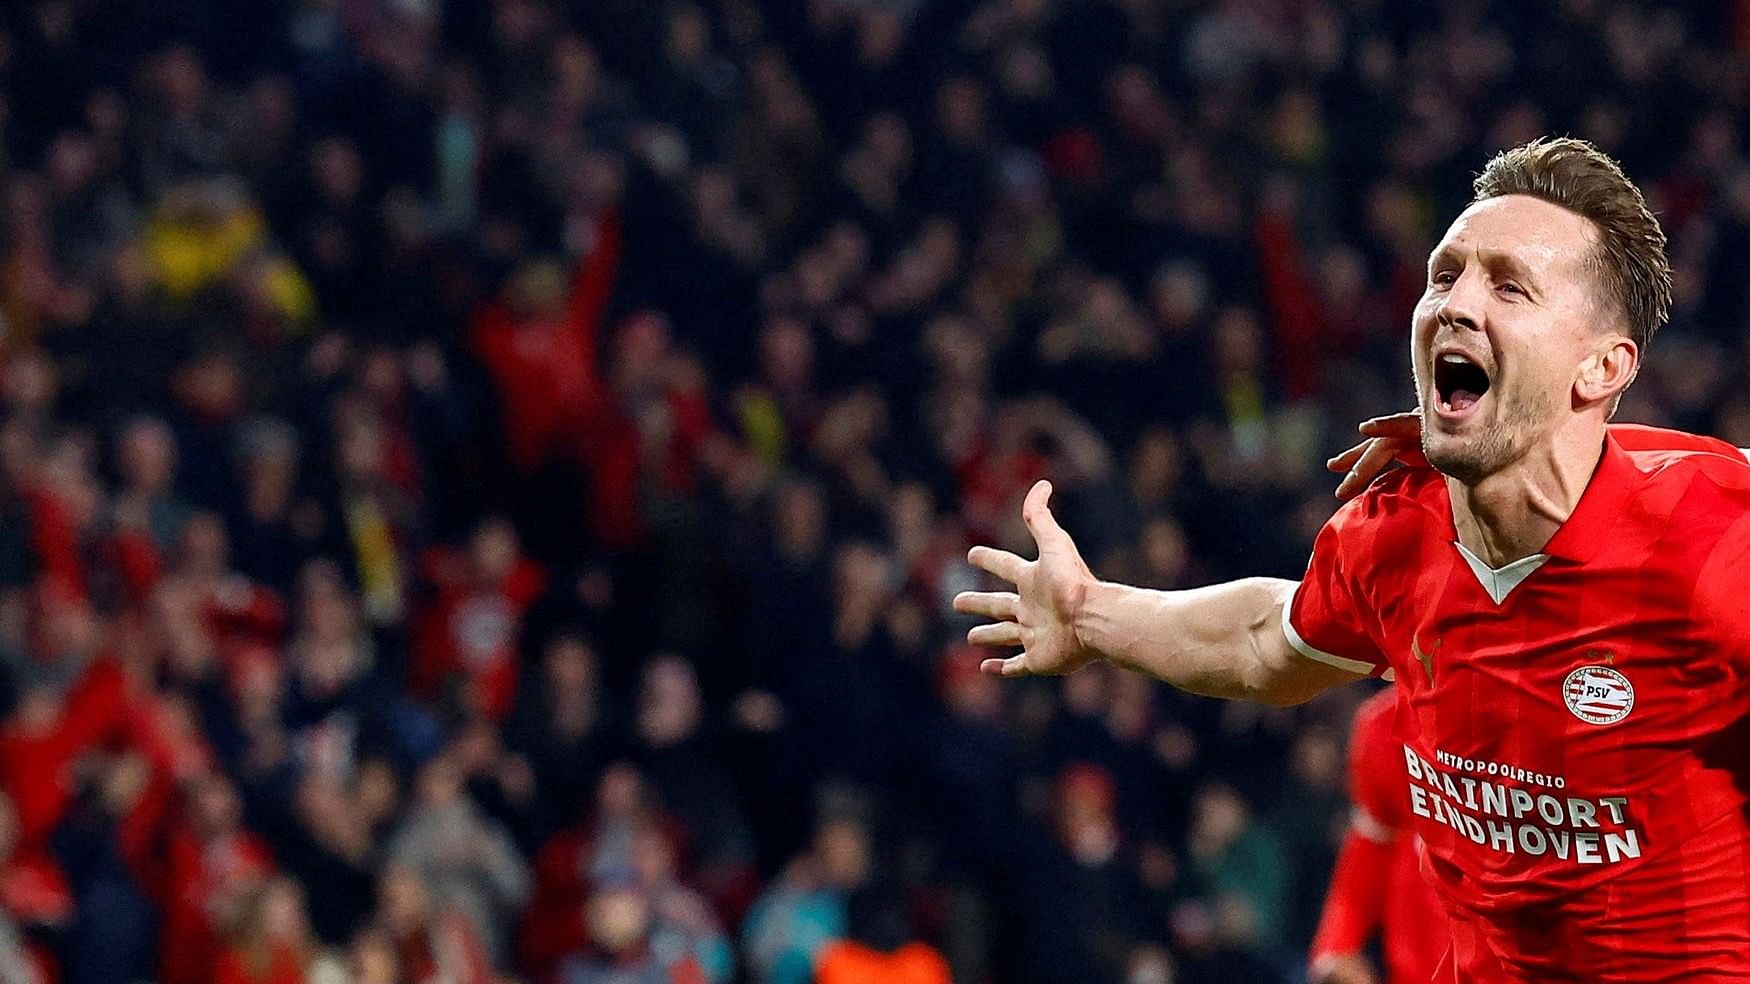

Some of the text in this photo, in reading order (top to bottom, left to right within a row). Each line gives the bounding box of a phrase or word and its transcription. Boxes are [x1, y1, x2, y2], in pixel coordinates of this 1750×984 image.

[1586, 685, 1610, 699] PSV
[1403, 744, 1627, 828] BRAINPORT
[1436, 749, 1565, 789] METROPOOLREGIO
[1409, 782, 1641, 864] EINDHOVEN
